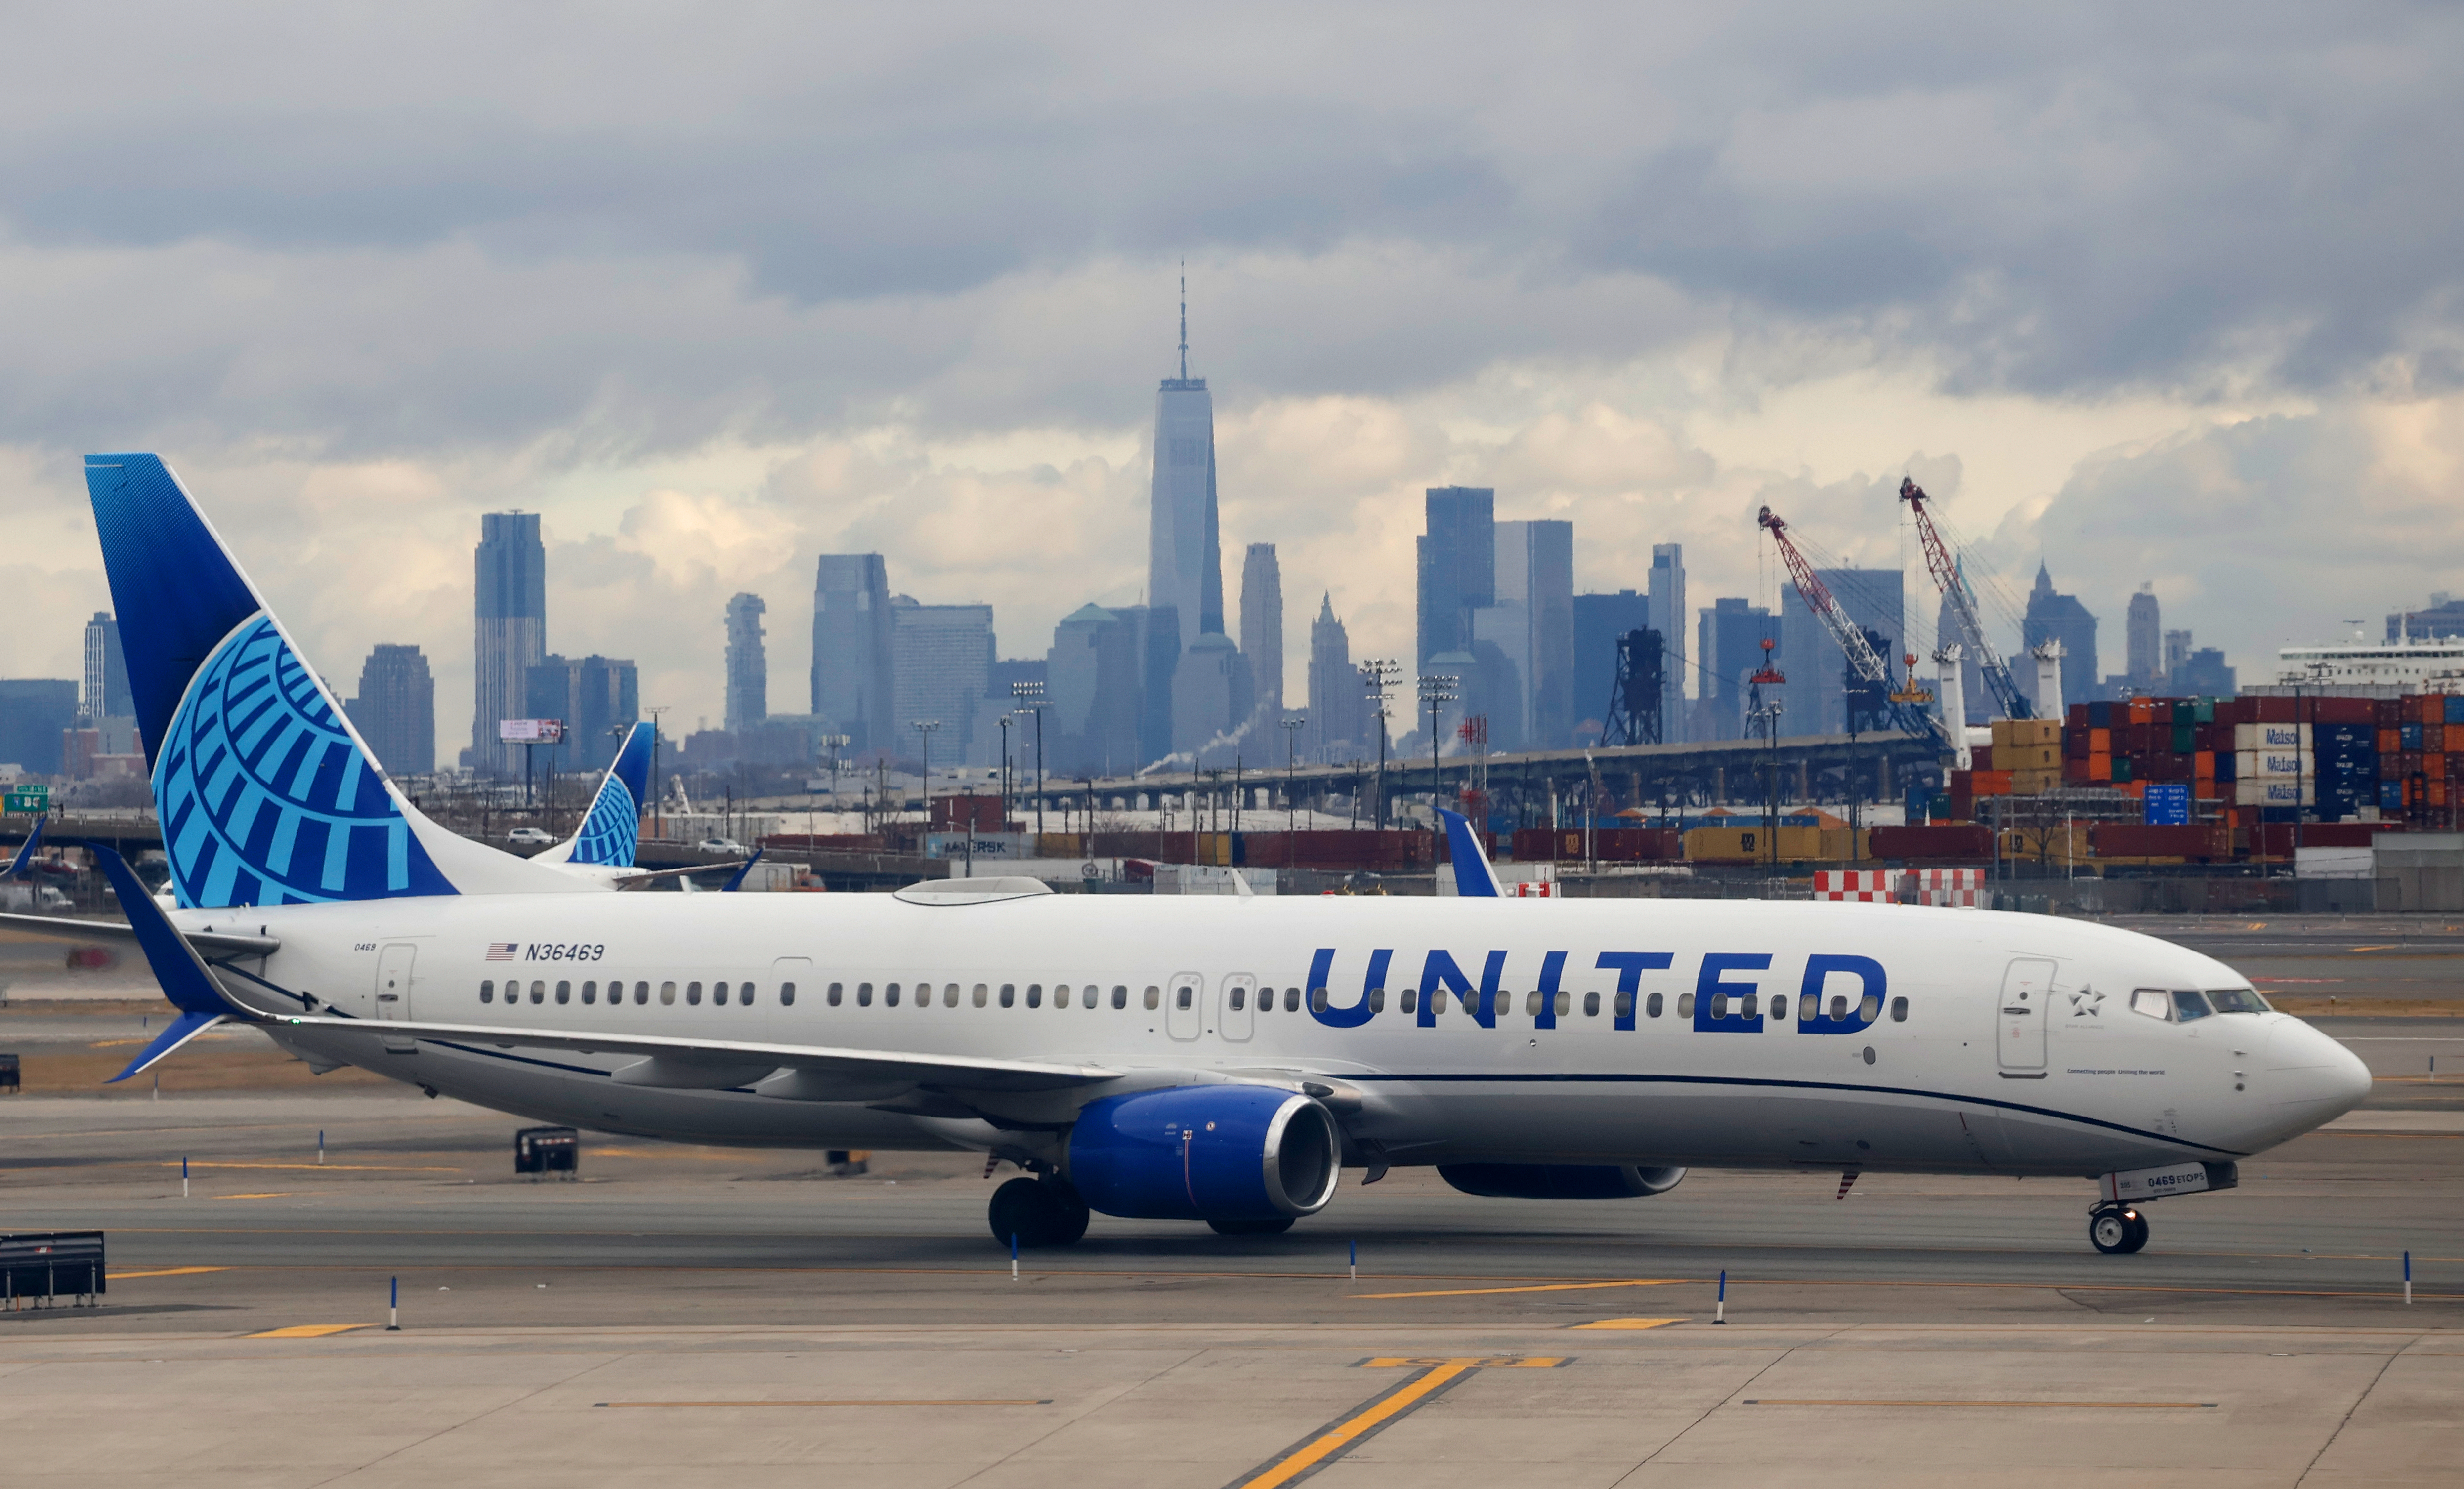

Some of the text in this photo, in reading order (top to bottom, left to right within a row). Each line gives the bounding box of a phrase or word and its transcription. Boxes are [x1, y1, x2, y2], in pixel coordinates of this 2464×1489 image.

[2267, 728, 2301, 744] Matso
[2268, 756, 2302, 773] Matso
[2268, 784, 2302, 799] Matso
[525, 943, 604, 961] N36469
[1305, 948, 1887, 1034] UNITED
[2148, 1175, 2175, 1187] 0469
[2176, 1172, 2205, 1183] ETOPS
